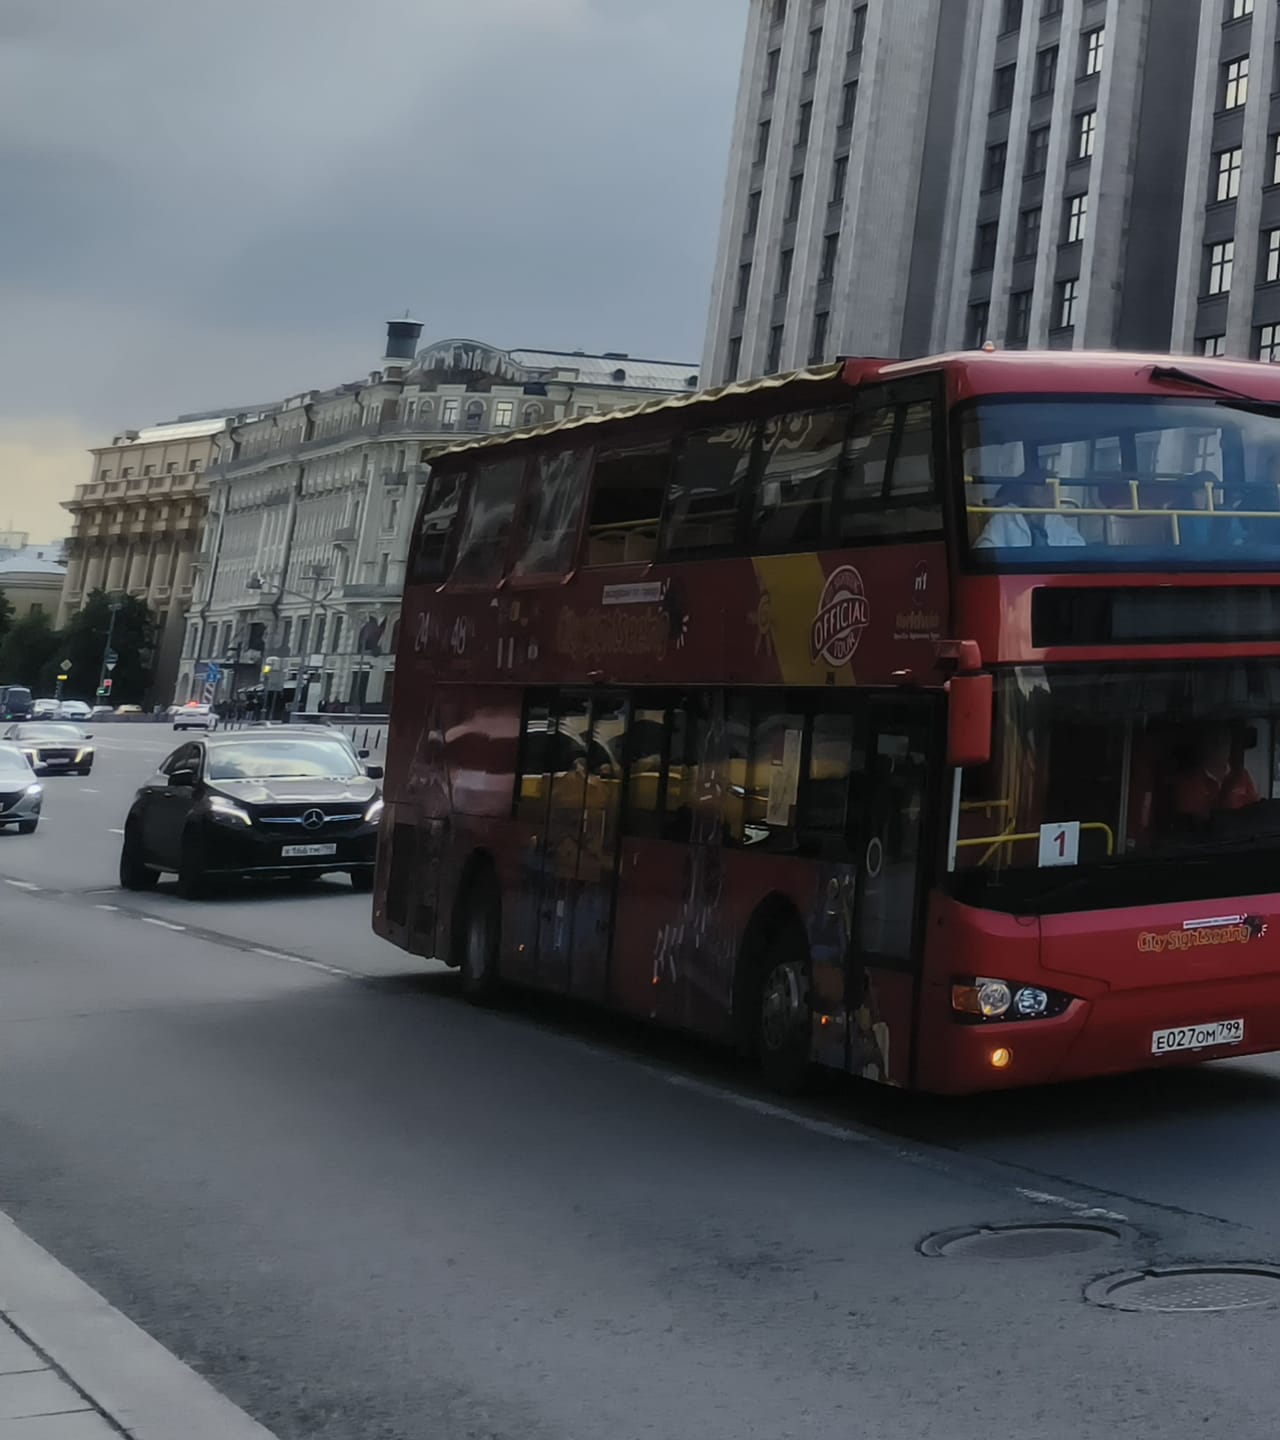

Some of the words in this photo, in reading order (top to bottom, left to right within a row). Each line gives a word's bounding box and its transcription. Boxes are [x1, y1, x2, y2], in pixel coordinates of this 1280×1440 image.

[814, 600, 867, 651] OFFICIAL
[833, 631, 856, 658] TOUR
[1053, 830, 1066, 857] 1
[1138, 931, 1167, 952] City
[1168, 927, 1251, 950] Sightseeing
